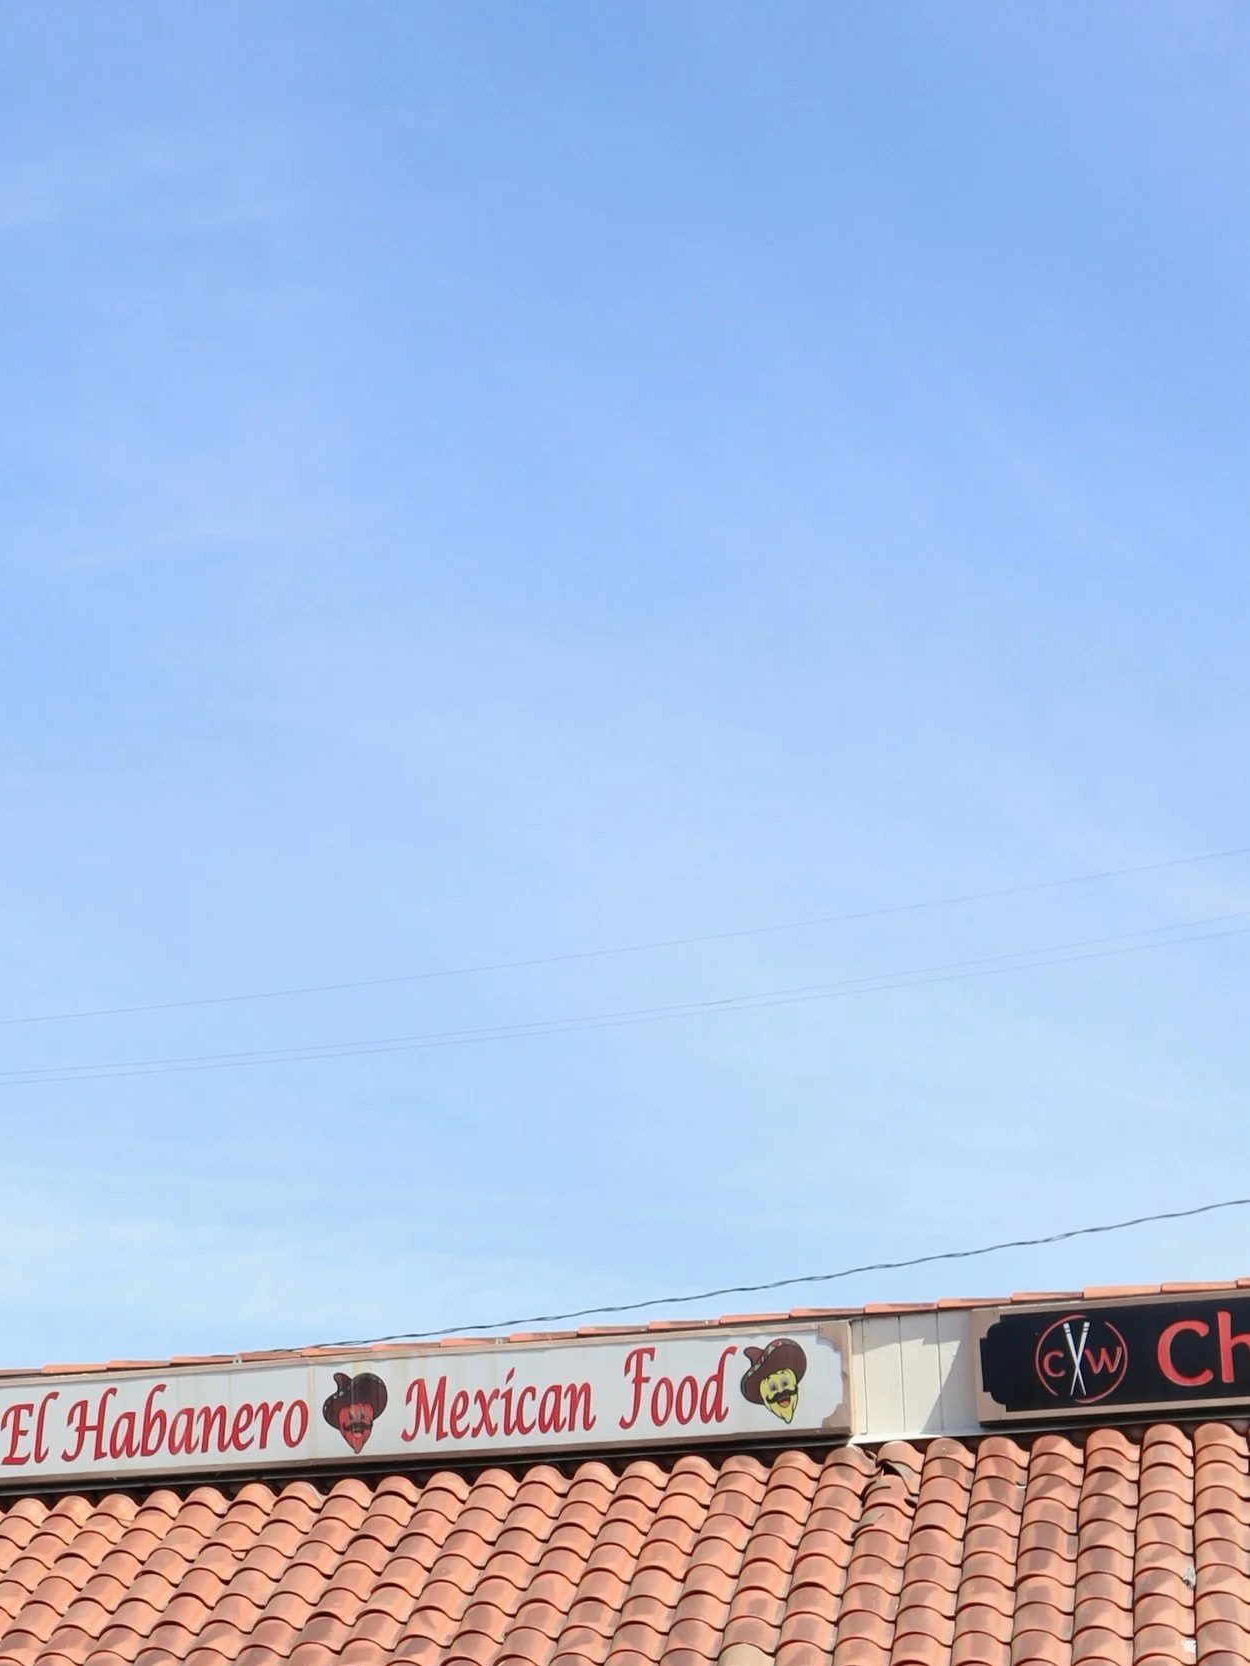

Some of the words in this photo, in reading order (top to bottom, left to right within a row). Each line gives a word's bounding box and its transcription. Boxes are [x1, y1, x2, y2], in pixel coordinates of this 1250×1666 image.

[0, 1391, 60, 1466] El
[61, 1384, 309, 1462] Habanero
[619, 1346, 738, 1430] Food
